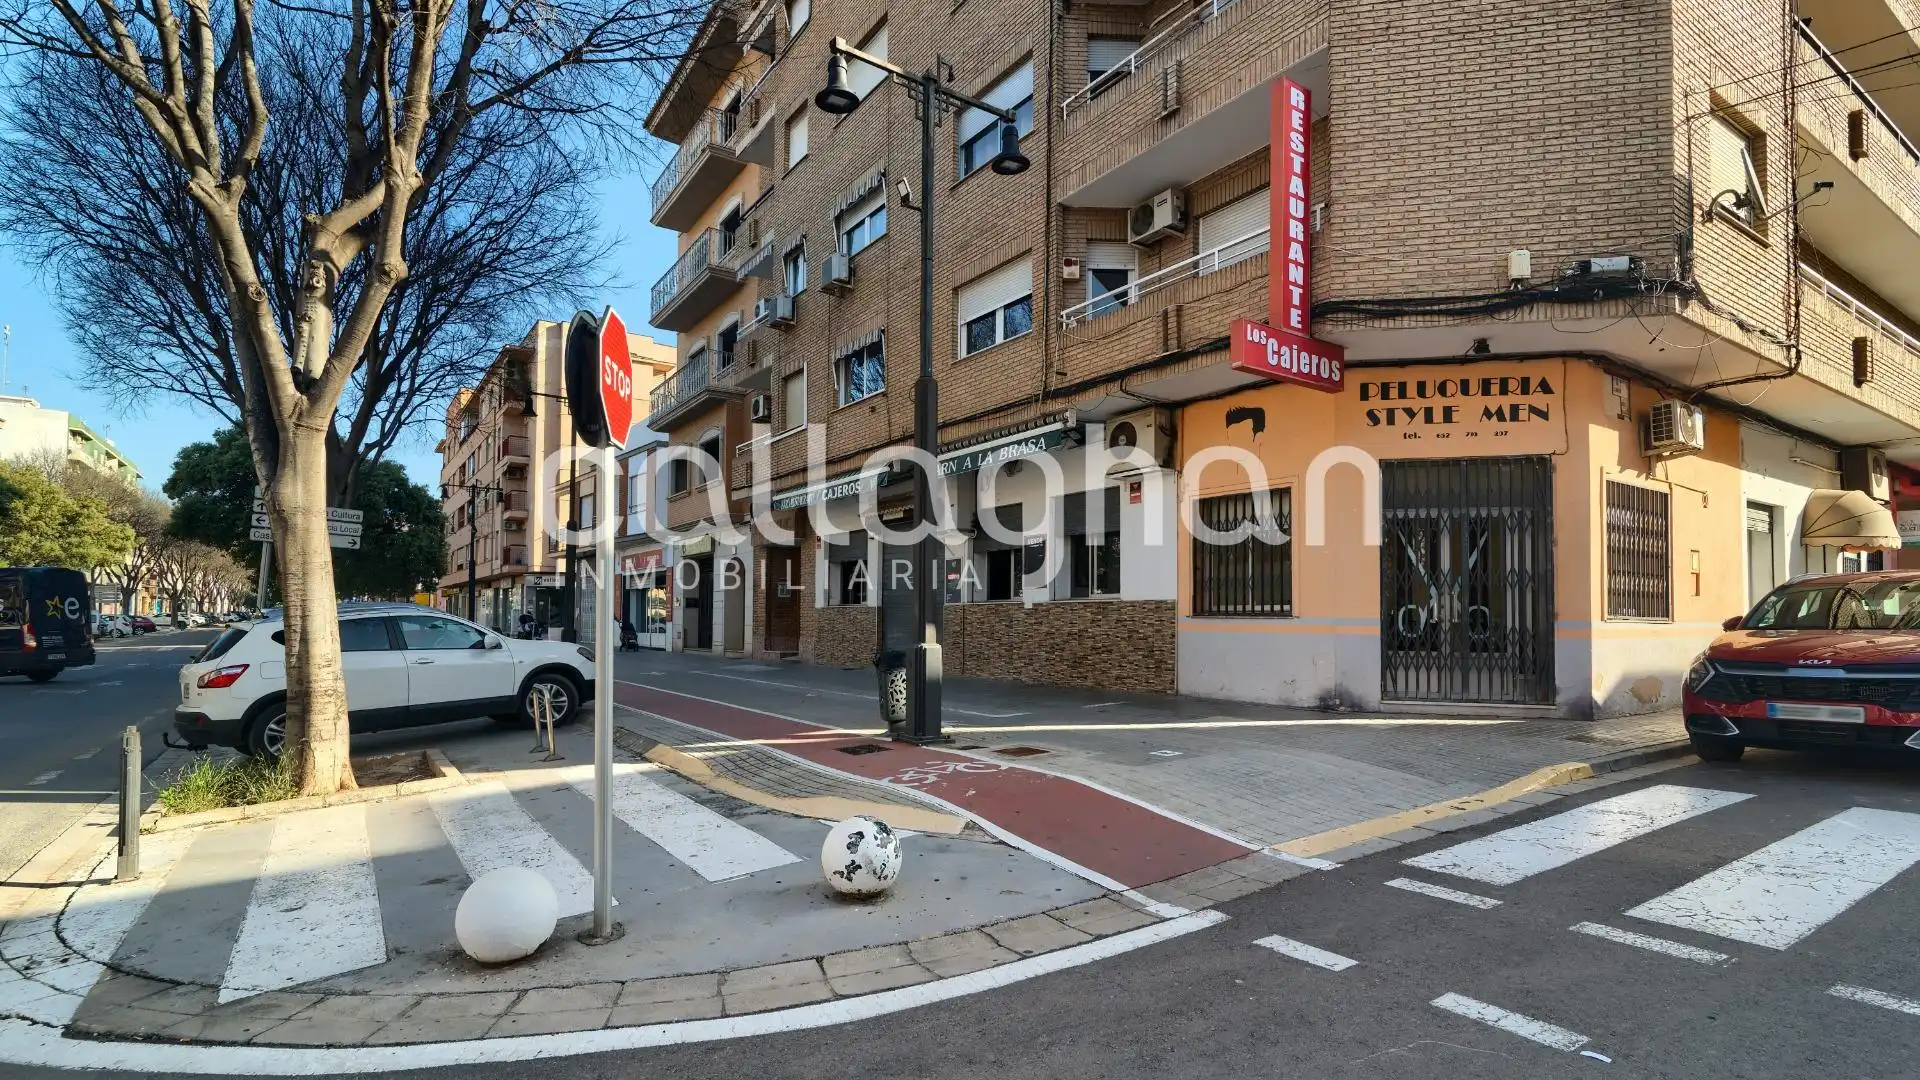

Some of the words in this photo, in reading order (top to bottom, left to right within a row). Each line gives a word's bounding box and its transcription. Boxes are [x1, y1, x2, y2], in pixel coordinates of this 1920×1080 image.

[1289, 86, 1305, 329] RESTAURANTE
[1266, 337, 1341, 382] Cajeros
[604, 355, 631, 400] STOP
[1359, 376, 1555, 401] PELUQUERIA
[1366, 405, 1460, 427] STYLE
[1479, 403, 1550, 423] MEN
[937, 460, 958, 476] ARN
[963, 456, 972, 470] A
[978, 451, 993, 467] LA
[1000, 436, 1046, 461] BRASA
[821, 481, 861, 500] CAJEROS
[331, 510, 360, 520] Cultura
[253, 530, 272, 539] Cas
[340, 525, 359, 534] Local
